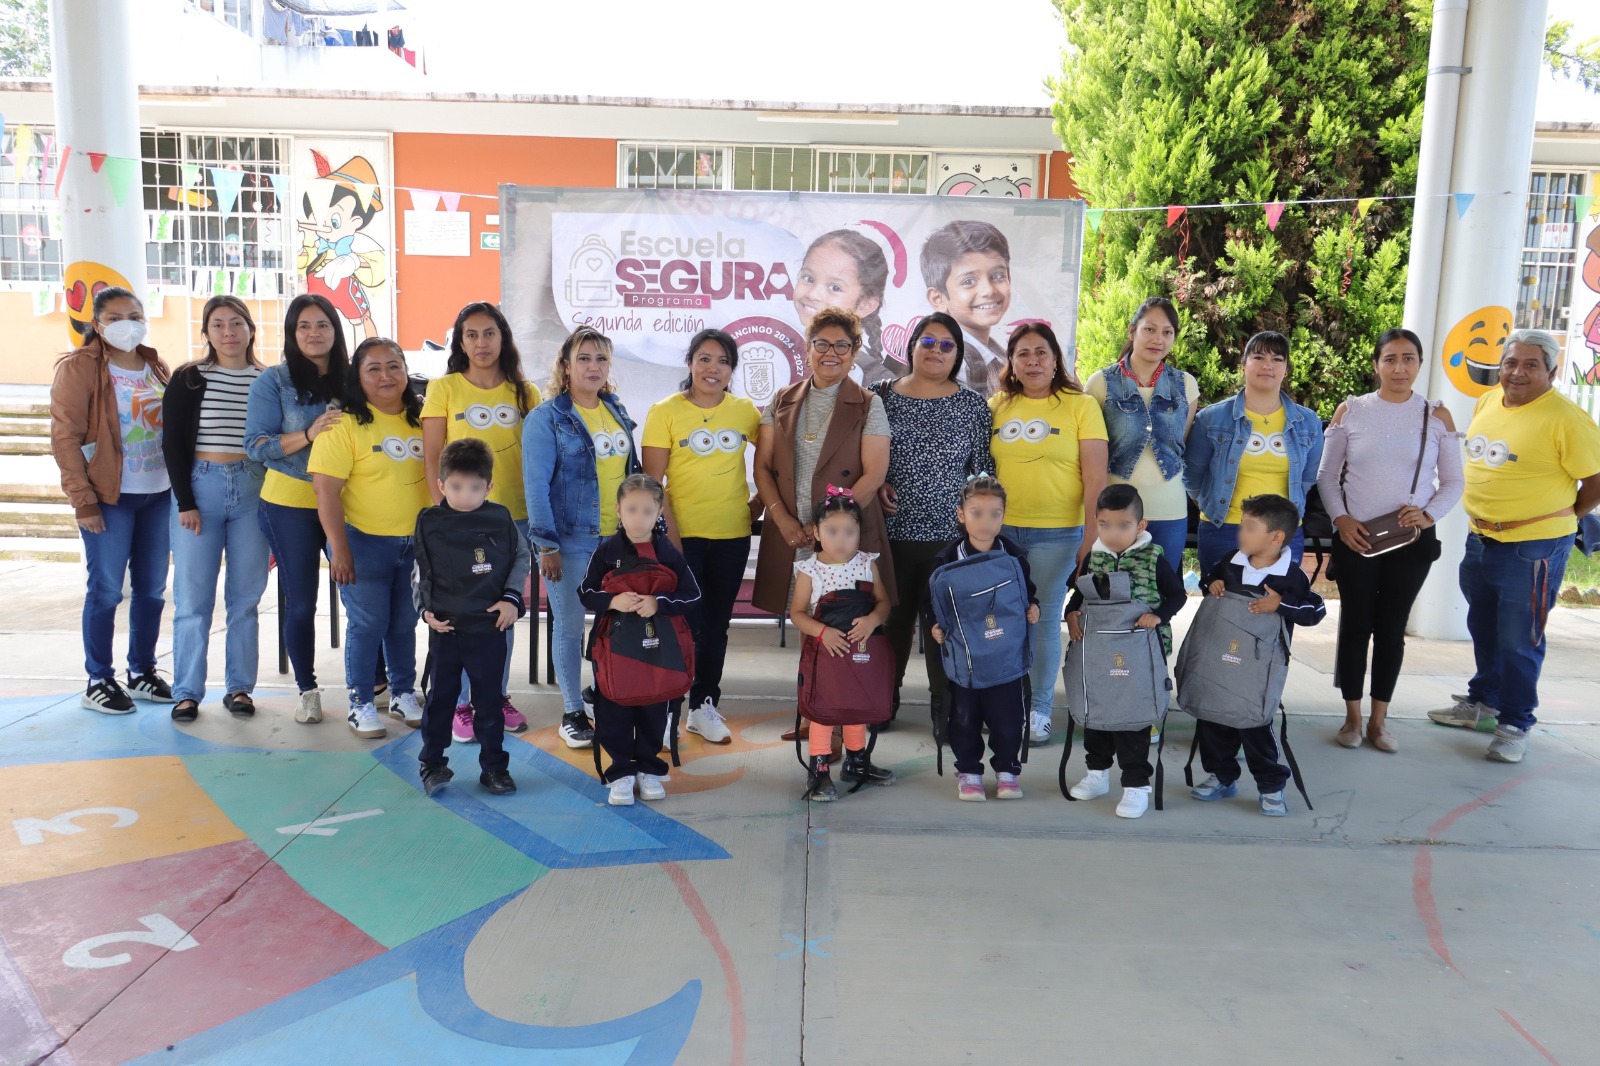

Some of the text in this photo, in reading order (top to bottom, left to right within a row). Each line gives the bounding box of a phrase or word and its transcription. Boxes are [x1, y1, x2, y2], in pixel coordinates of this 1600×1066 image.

[620, 230, 745, 258] Escuela
[615, 258, 795, 301] SEGURA
[632, 295, 702, 306] Programa
[571, 309, 705, 334] Segunda edición
[730, 325, 773, 340] ANCINGO
[773, 330, 795, 349] 2024
[793, 353, 804, 377] 2027
